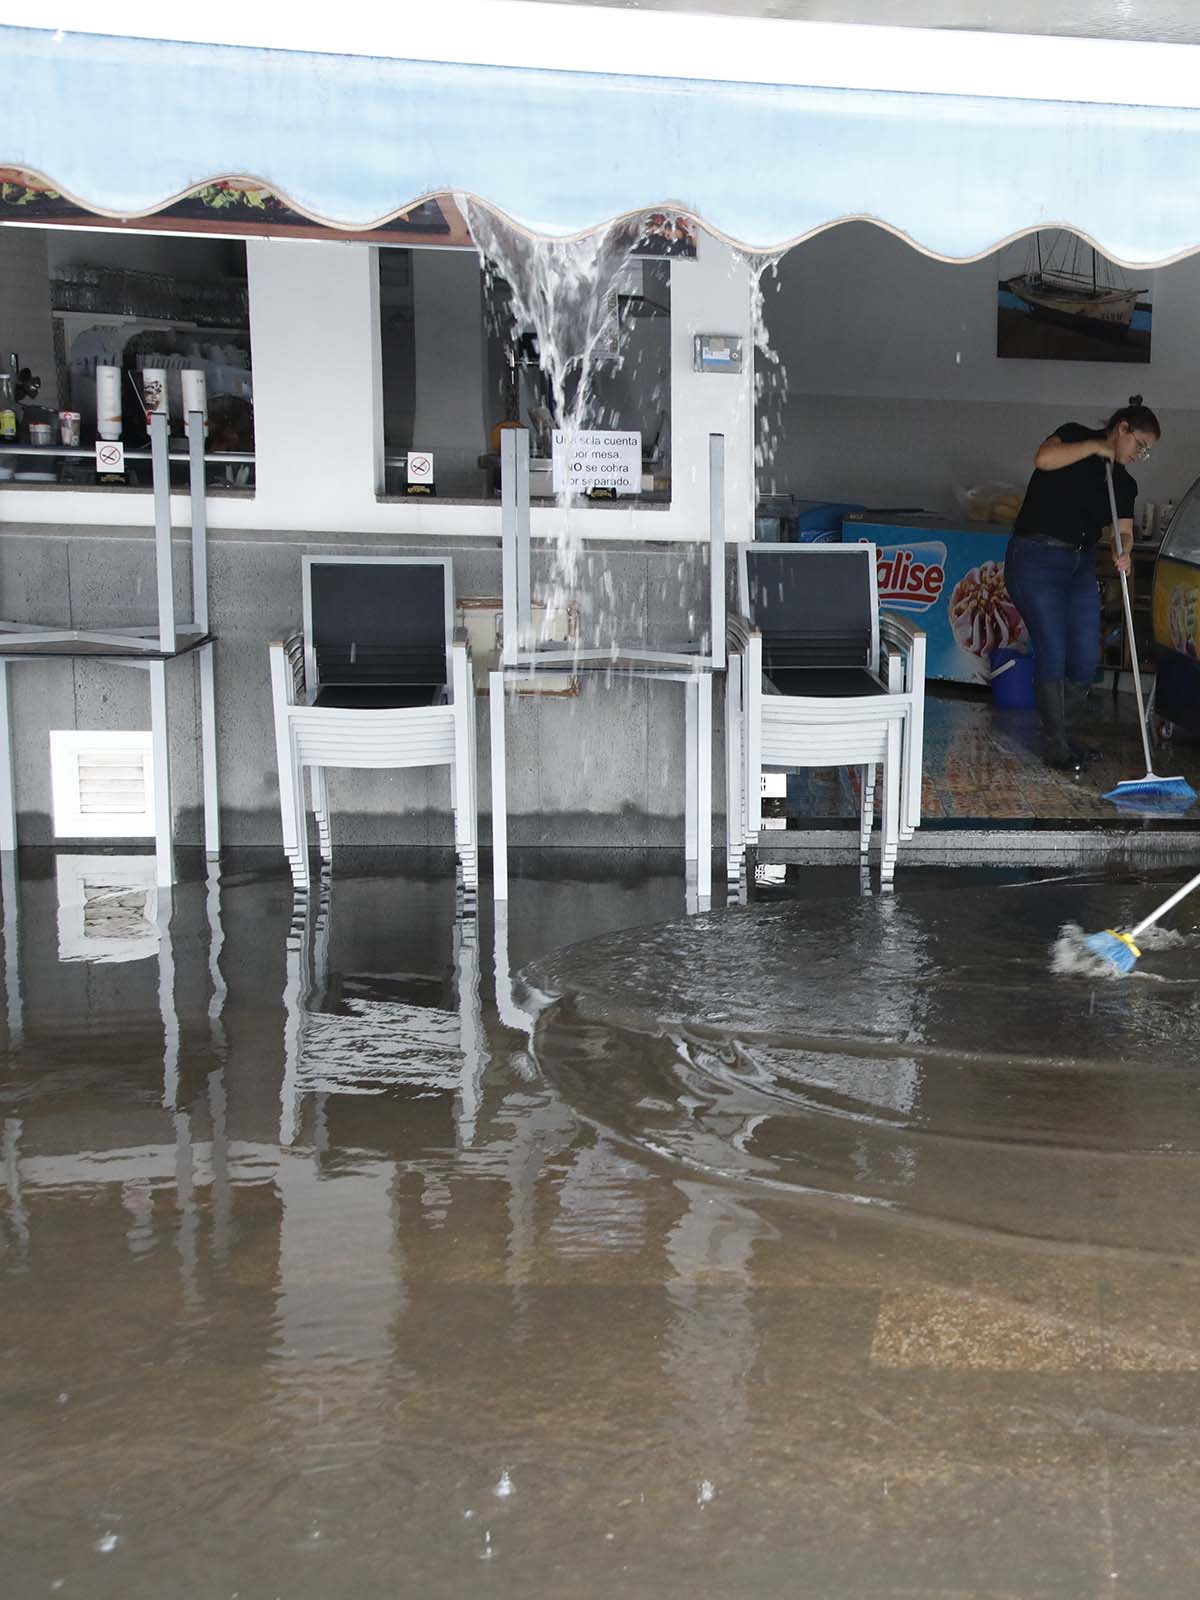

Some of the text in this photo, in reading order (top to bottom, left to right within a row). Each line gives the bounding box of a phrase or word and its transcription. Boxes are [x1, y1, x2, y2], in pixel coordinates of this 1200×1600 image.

[604, 437, 638, 446] cuenta
[585, 464, 598, 473] se
[601, 463, 629, 473] cobra
